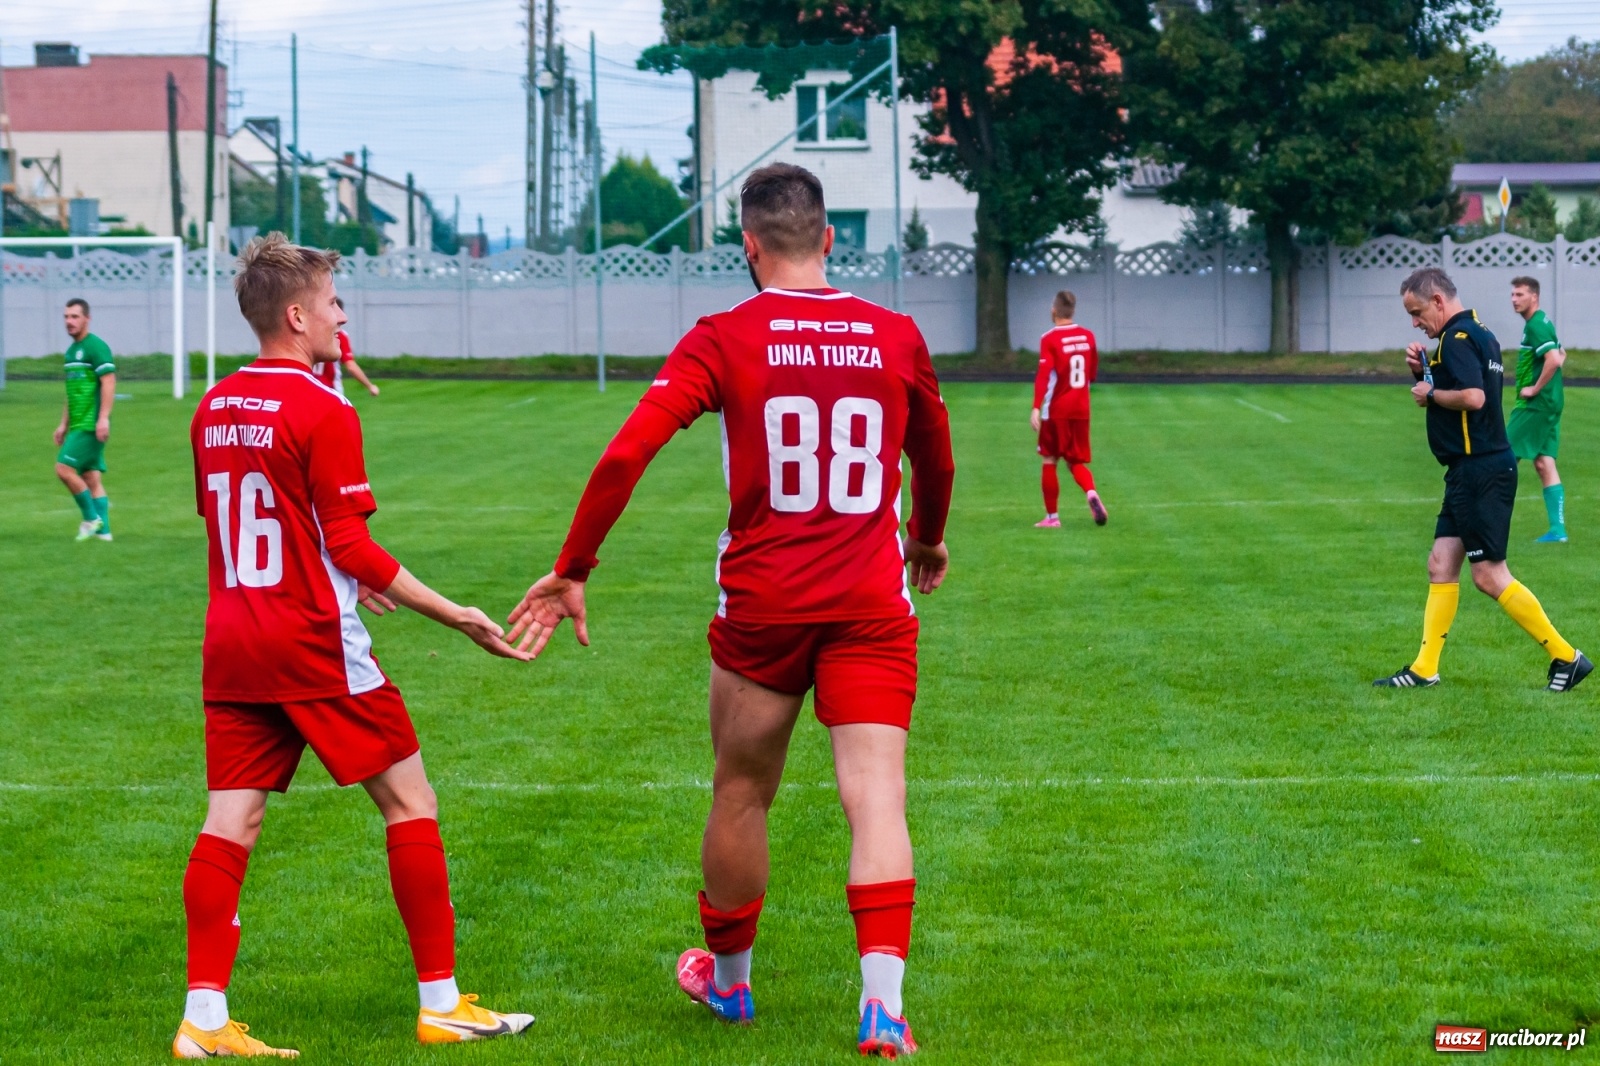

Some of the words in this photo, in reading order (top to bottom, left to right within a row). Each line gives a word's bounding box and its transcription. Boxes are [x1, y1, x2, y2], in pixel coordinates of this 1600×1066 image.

[769, 319, 874, 334] GROS
[767, 344, 816, 366] UNIA
[820, 345, 883, 369] TURZA
[1070, 354, 1086, 388] 8
[209, 396, 282, 412] GROS
[204, 424, 237, 448] UNIA
[238, 425, 274, 449] TURZA
[764, 395, 883, 514] 88
[207, 471, 283, 588] 16
